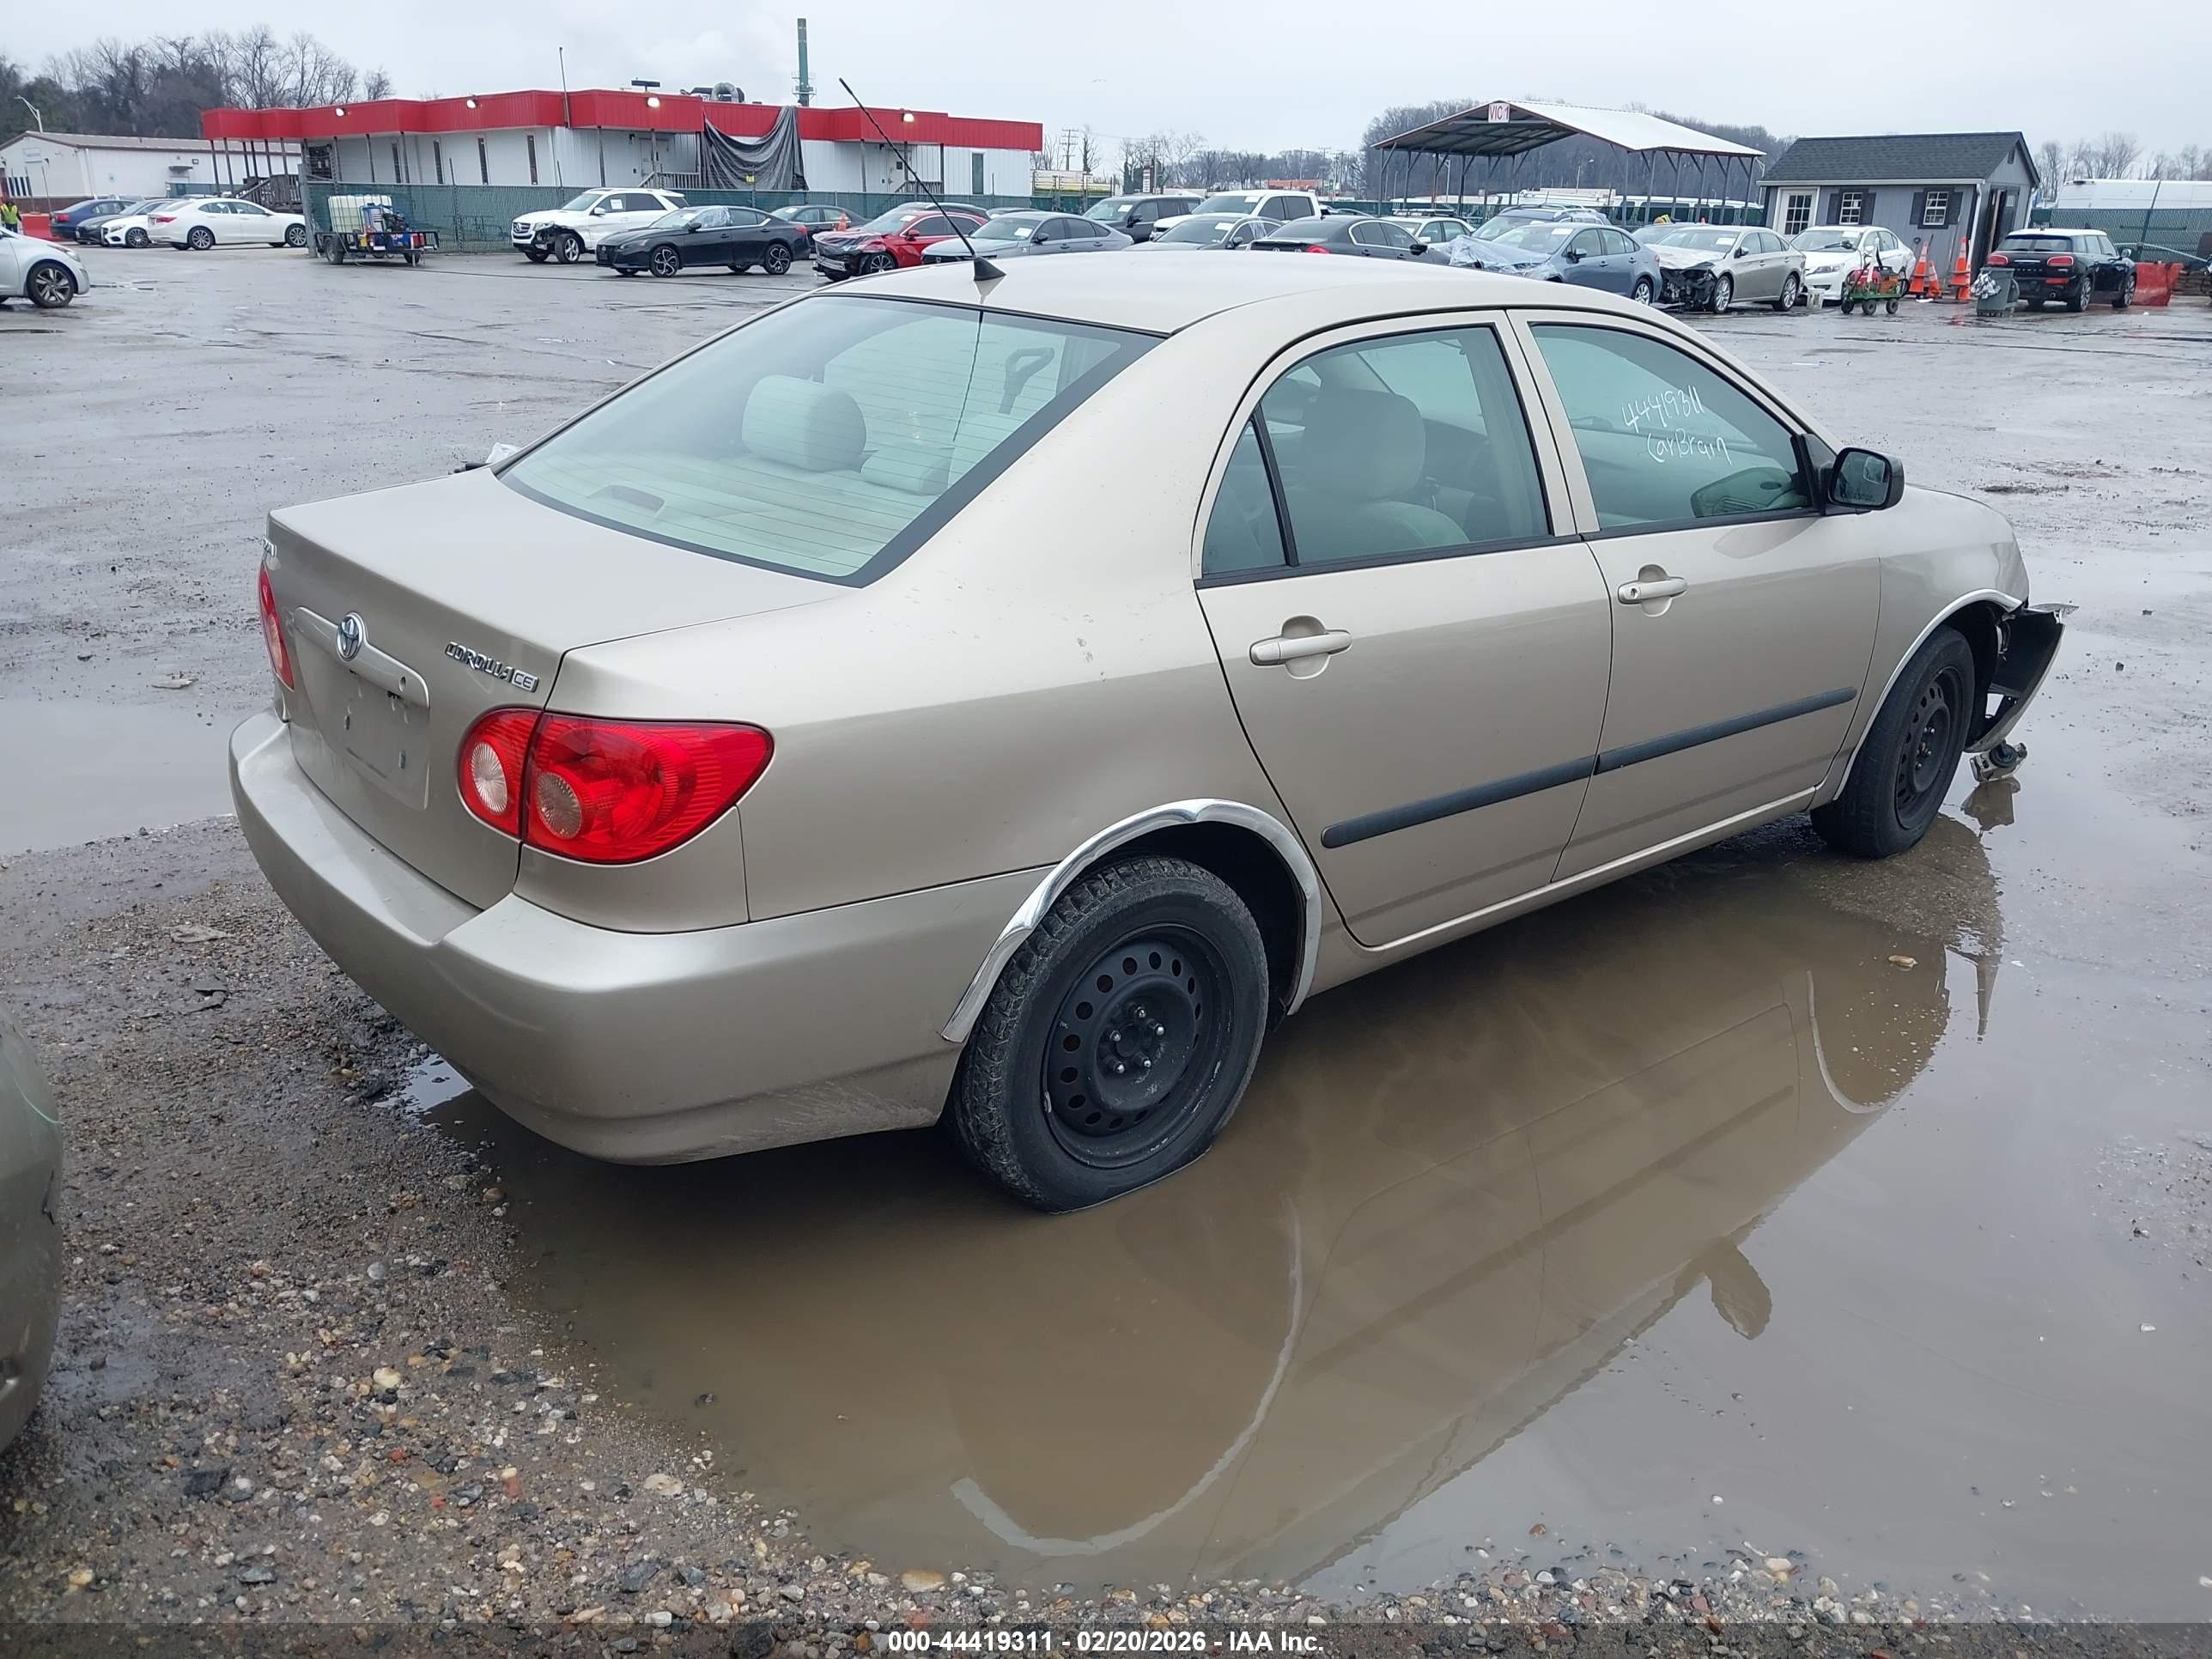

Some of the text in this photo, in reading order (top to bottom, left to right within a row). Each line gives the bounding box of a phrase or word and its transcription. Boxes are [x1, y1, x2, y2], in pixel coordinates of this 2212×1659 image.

[1489, 105, 1510, 120] VIC 1
[1621, 385, 1704, 433] 44419311
[445, 641, 534, 690] COROLLA CE
